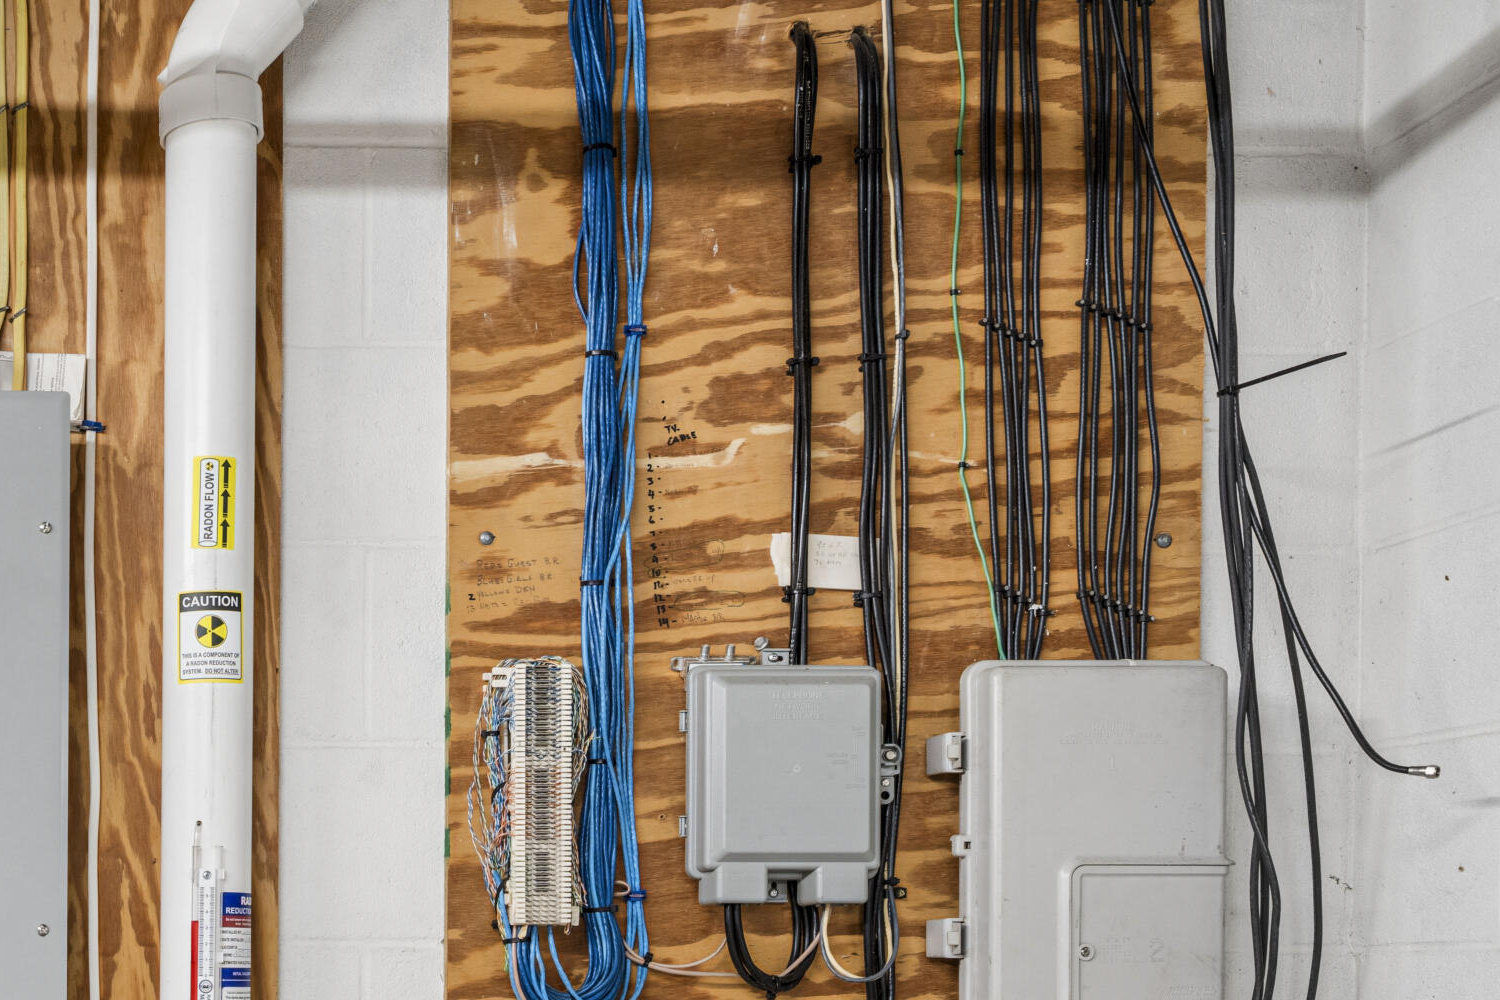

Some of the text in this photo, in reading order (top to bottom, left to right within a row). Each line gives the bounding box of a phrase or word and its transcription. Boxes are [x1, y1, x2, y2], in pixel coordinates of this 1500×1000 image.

[667, 431, 697, 446] CABLE
[204, 472, 215, 539] RADON FLOW
[182, 596, 239, 608] CAUTION
